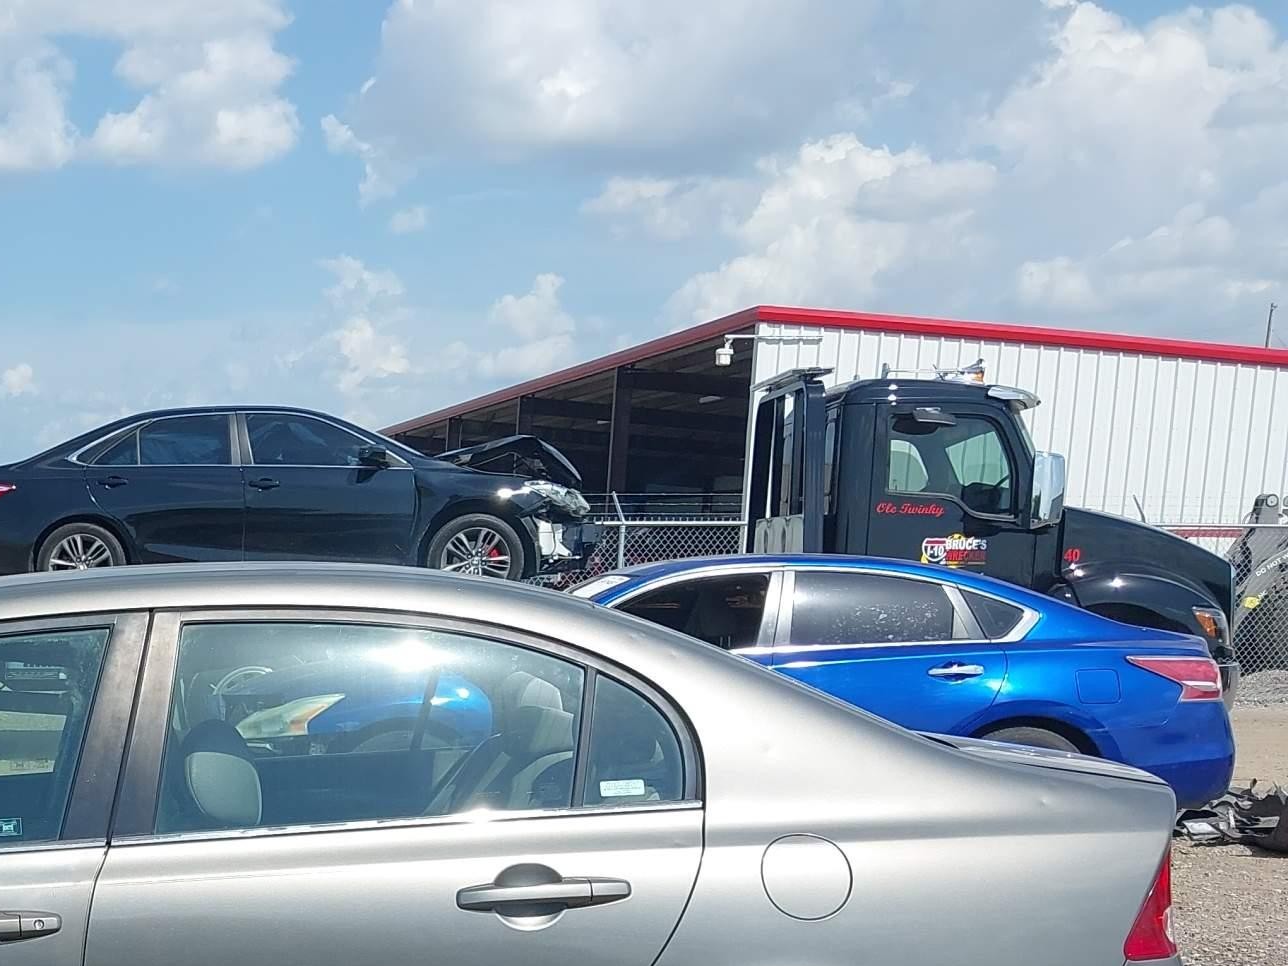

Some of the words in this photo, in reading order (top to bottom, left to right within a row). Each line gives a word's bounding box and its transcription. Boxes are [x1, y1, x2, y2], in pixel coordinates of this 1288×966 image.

[876, 503, 897, 514] Ole
[899, 503, 945, 518] Twinky
[946, 537, 987, 550] BRUCE'S
[1063, 548, 1081, 562] 40
[1256, 568, 1266, 576] DO
[1267, 558, 1282, 569] NOT
